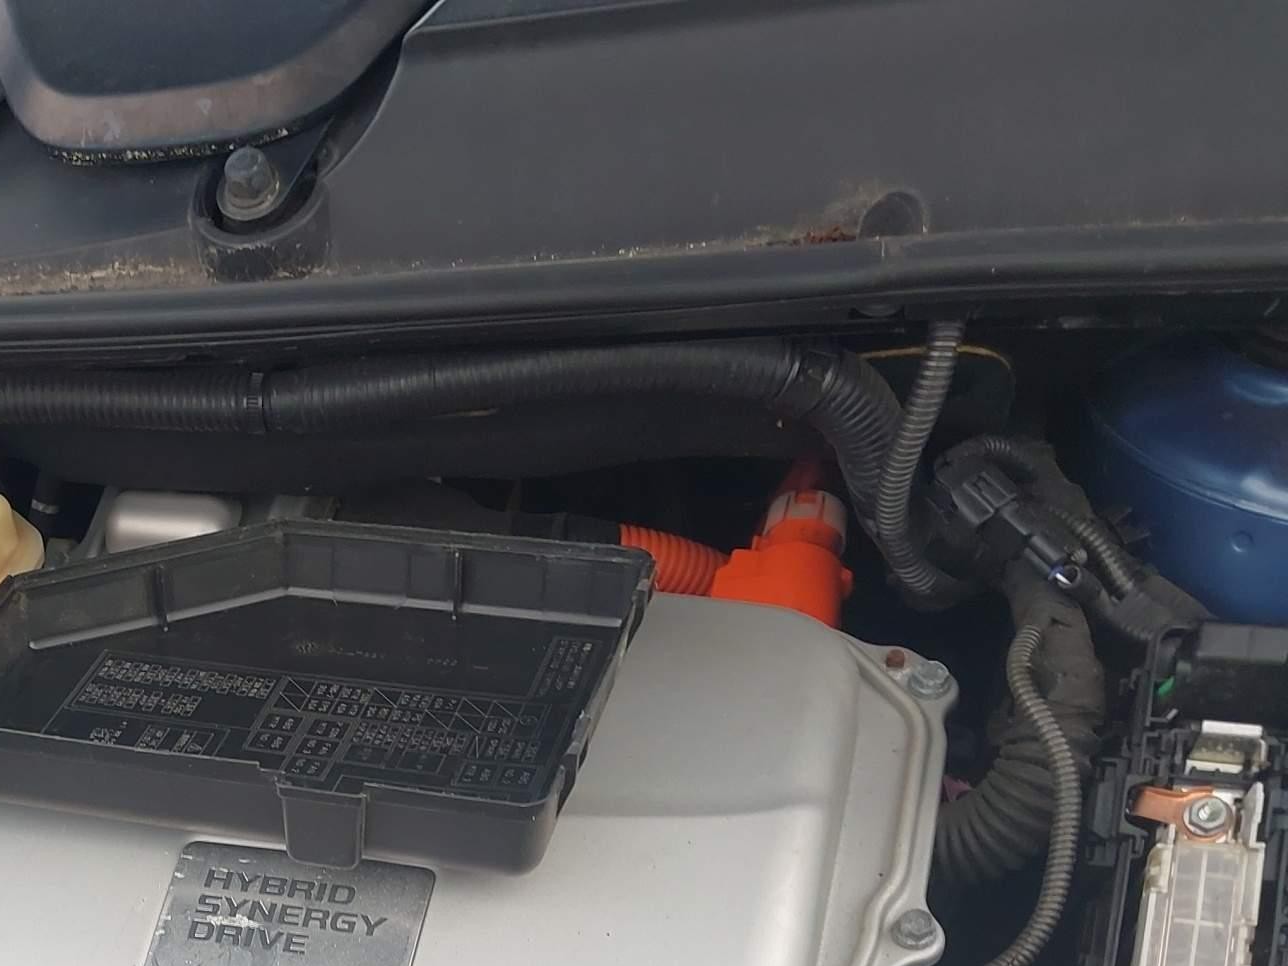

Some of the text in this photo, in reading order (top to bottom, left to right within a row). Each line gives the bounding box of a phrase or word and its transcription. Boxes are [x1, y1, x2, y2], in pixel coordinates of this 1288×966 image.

[203, 867, 357, 905] HYBRID
[195, 894, 388, 936] SYNERGY
[188, 919, 309, 955] DRIVE
